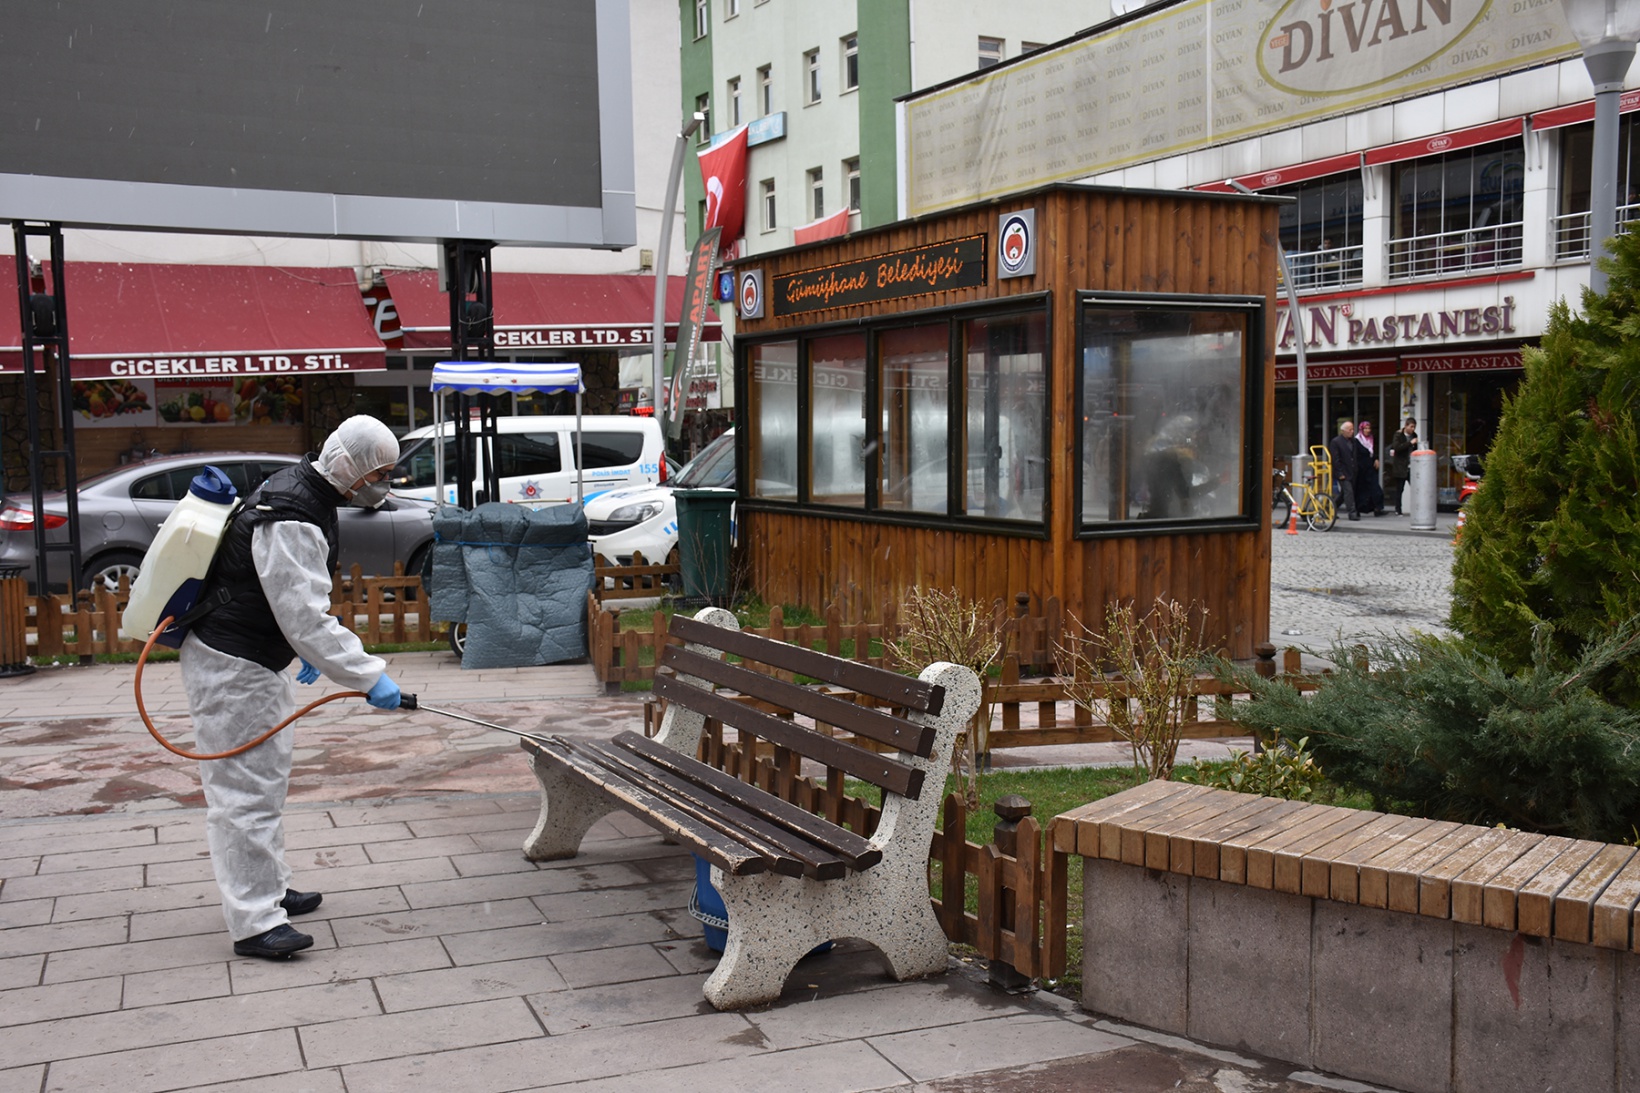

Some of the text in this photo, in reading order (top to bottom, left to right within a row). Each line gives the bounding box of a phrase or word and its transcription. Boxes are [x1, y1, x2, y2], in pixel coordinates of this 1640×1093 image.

[1279, 0, 1451, 73] DİVAN
[877, 247, 963, 288] Belediyesi
[1347, 296, 1515, 343] PASTANESİ
[493, 330, 576, 346] CEKLER
[581, 330, 625, 344] LTD.
[244, 356, 299, 372] LTD.
[1306, 364, 1370, 378] ASTANESİ
[1407, 355, 1524, 371] DİVAN PASTAN
[639, 463, 658, 474] 155
